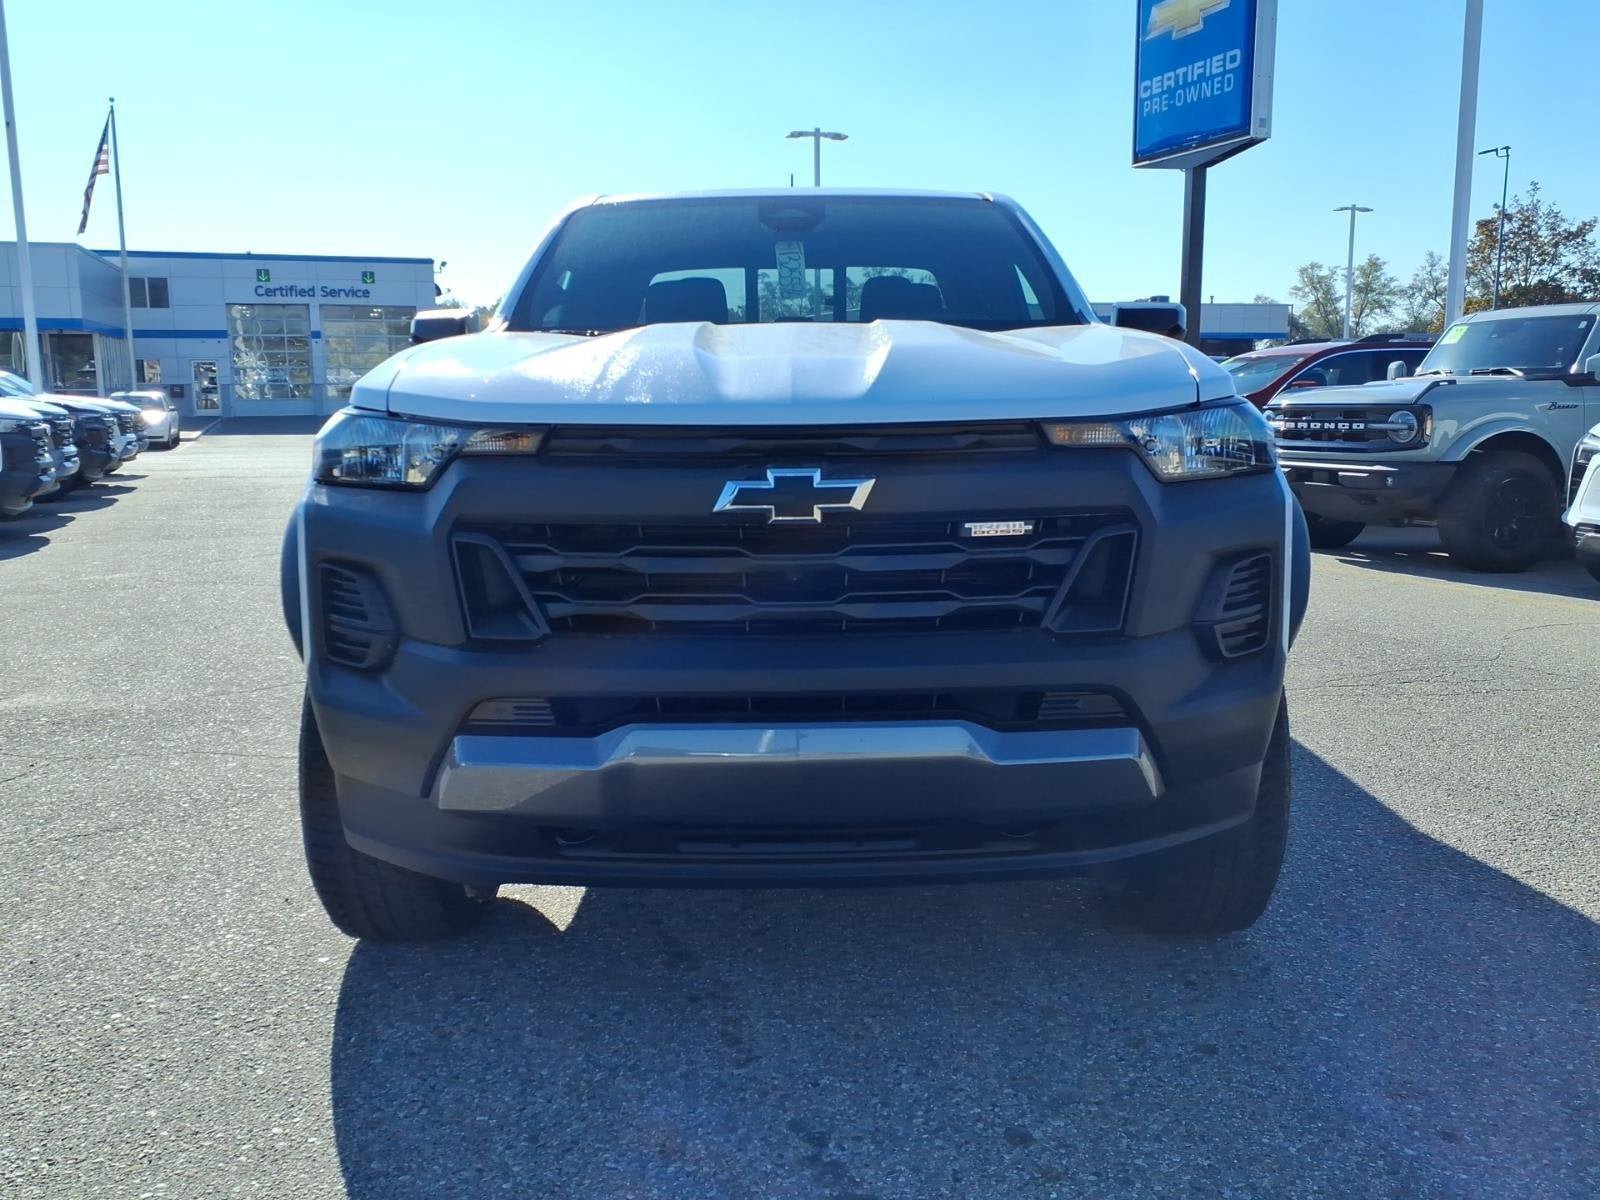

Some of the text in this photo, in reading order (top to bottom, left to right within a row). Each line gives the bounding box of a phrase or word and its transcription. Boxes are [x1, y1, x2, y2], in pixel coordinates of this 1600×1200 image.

[1140, 48, 1241, 98] CERTIFIED
[1143, 73, 1234, 117] PRE-OWNED
[254, 285, 370, 298] Certified Service
[1285, 422, 1365, 430] BRONCO
